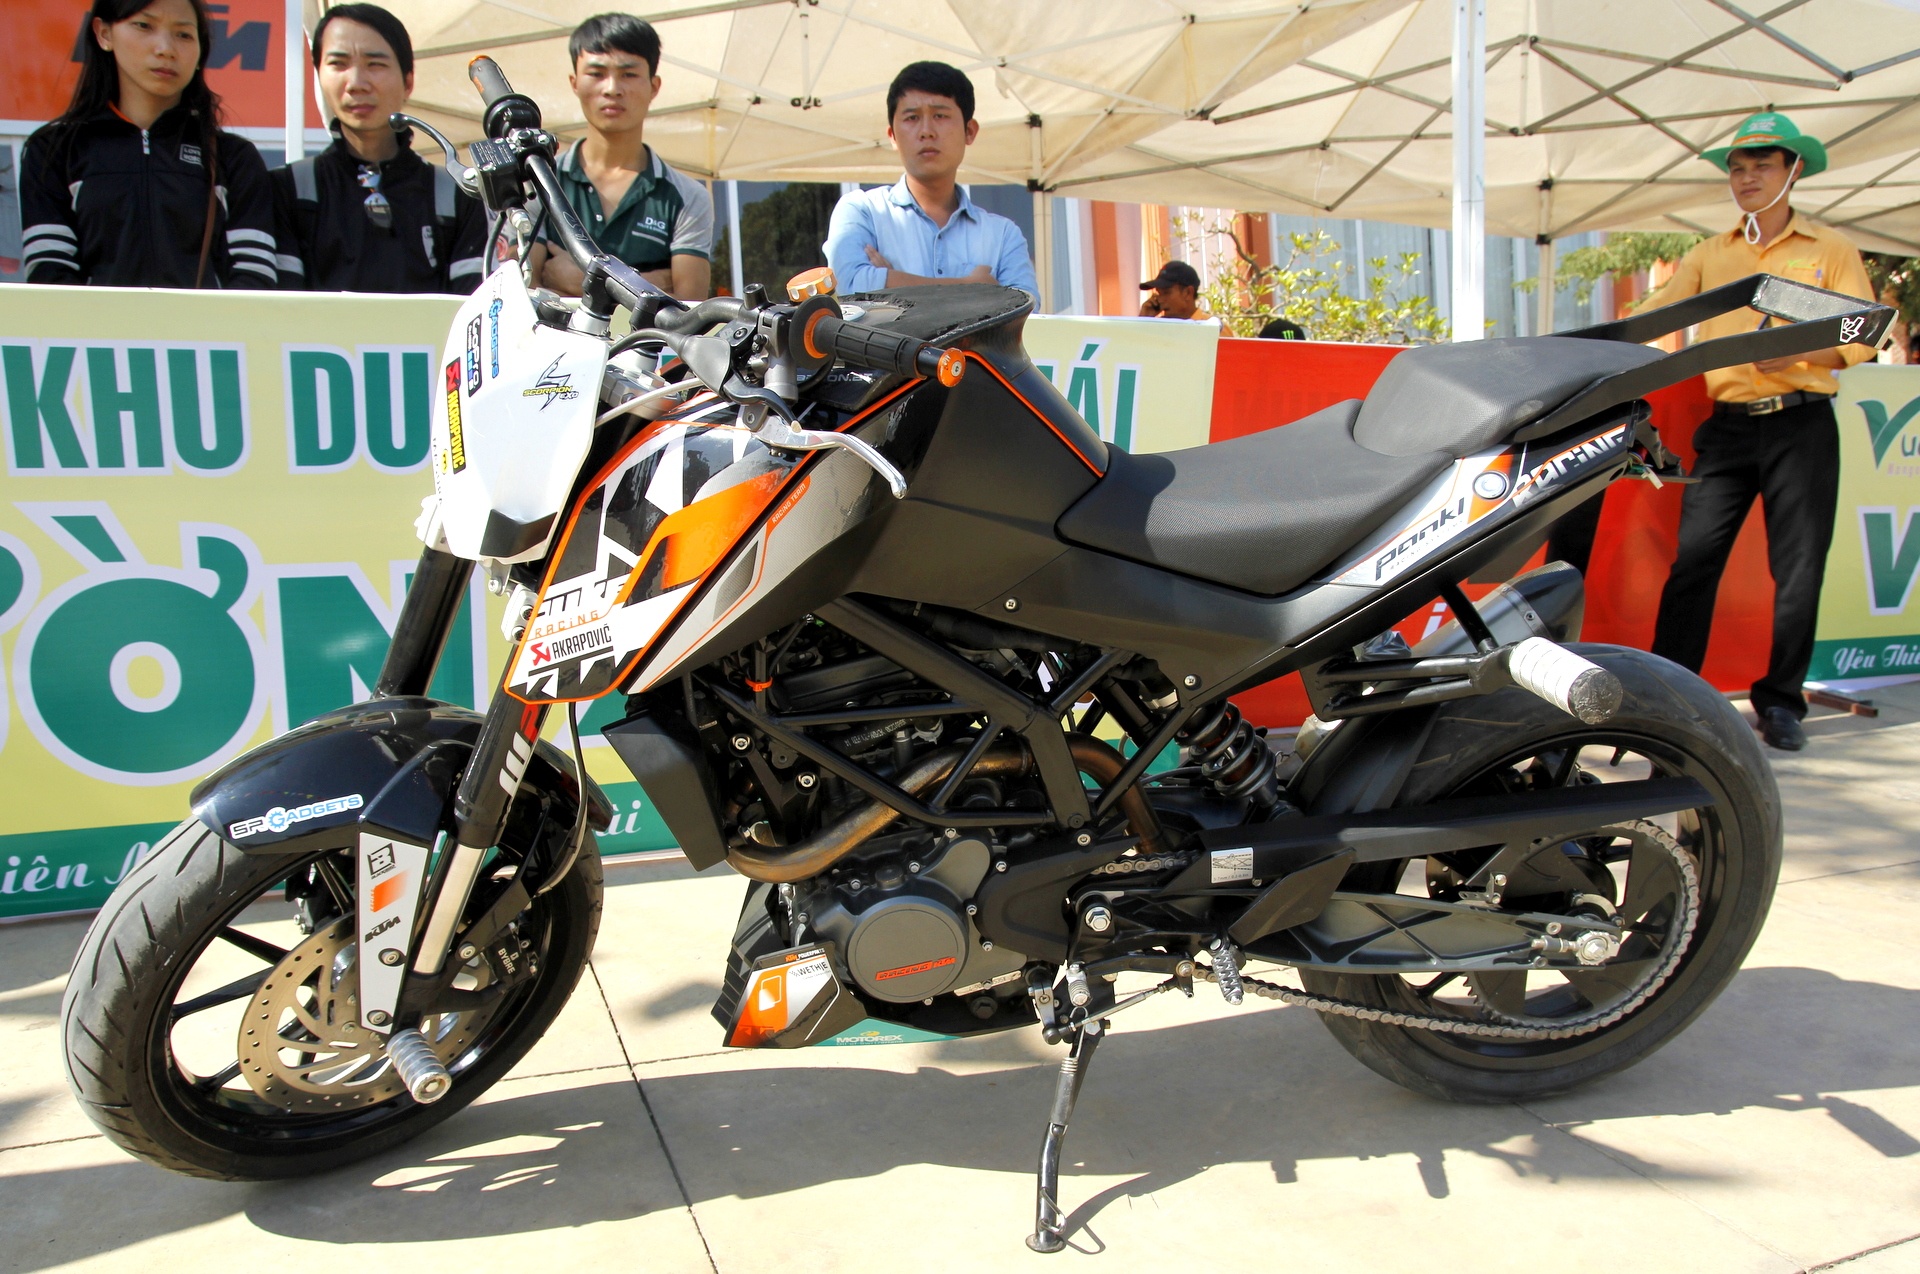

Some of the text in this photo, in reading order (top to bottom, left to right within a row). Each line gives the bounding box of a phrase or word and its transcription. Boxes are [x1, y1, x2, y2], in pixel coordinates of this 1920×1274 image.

[523, 385, 573, 397] SCORPION
[3, 346, 245, 470] KHU
[289, 350, 431, 469] DU
[1036, 343, 1137, 455] ÁI
[551, 623, 613, 660] AKRAPOVIČ
[1833, 647, 1877, 676] Yêu
[267, 796, 361, 829] GADGETS
[364, 916, 401, 943] KTM
[497, 947, 516, 975] BYBRE
[836, 1034, 904, 1043] MOTOREX
